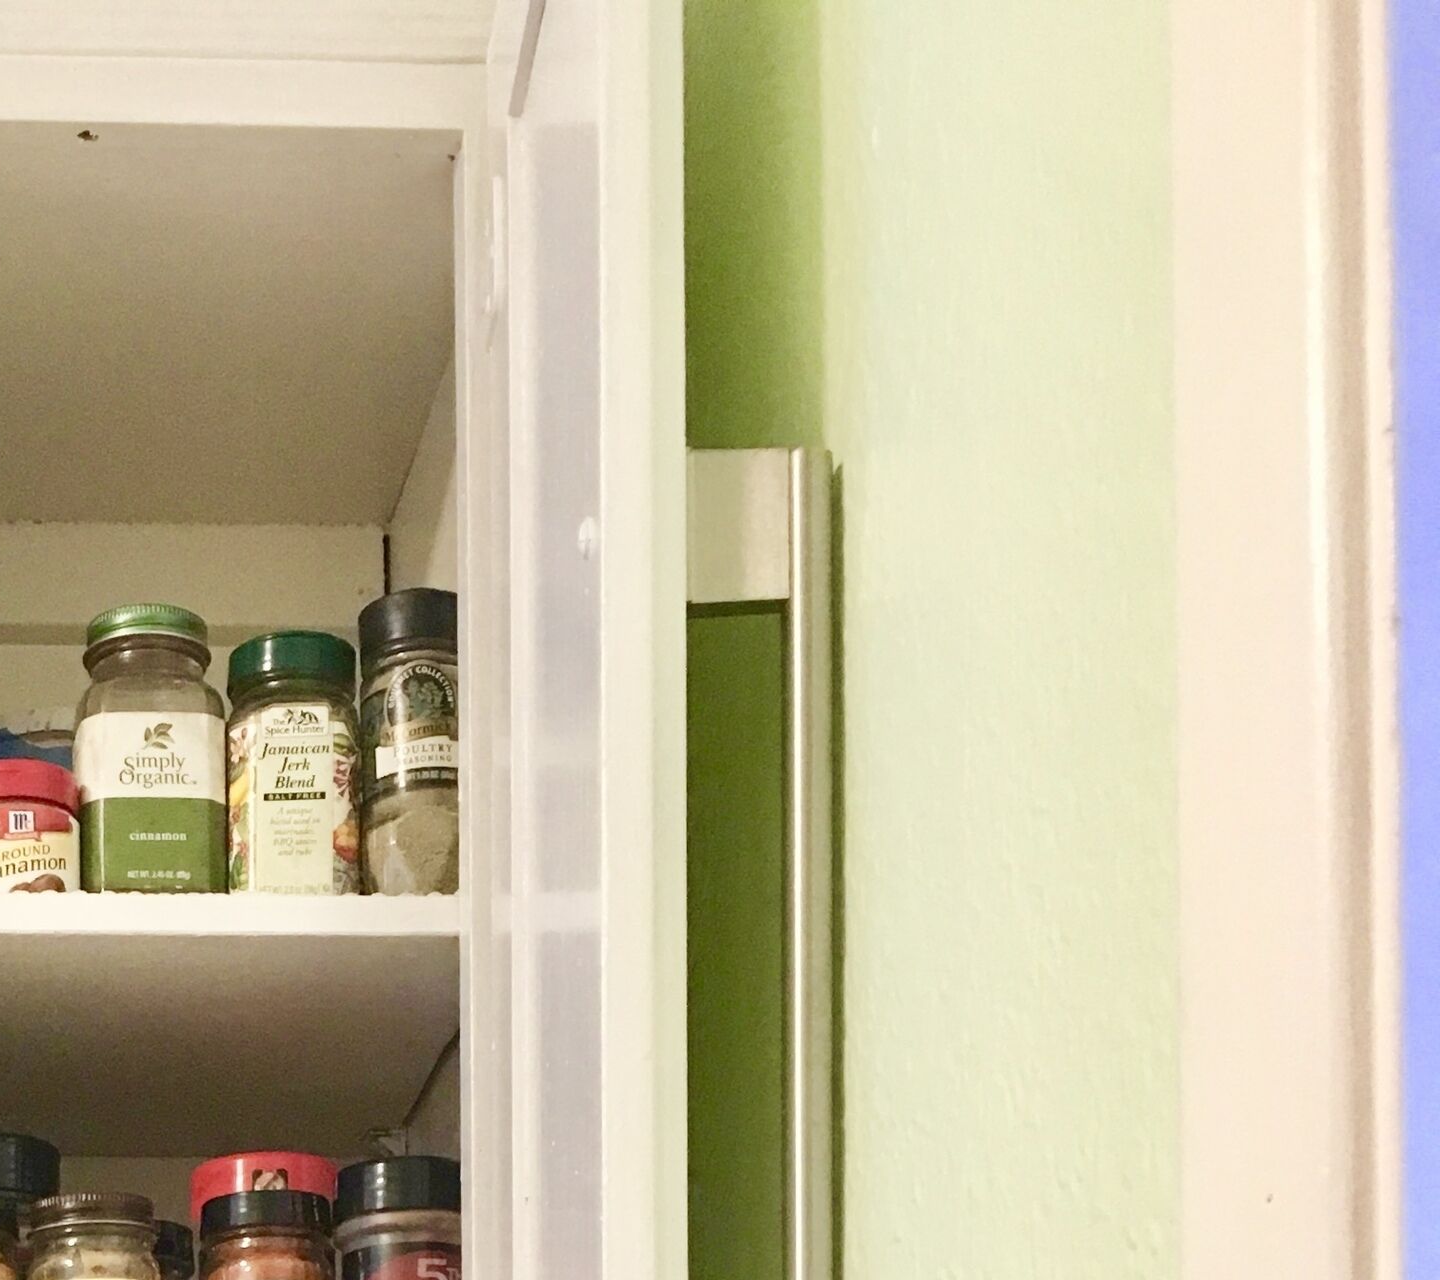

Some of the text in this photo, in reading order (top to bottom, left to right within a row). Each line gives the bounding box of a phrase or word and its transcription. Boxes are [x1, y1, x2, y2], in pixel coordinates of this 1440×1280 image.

[416, 665, 455, 702] COLLECTION
[265, 726, 324, 736] Spice Hunter
[258, 743, 330, 760] Jamaican
[394, 744, 453, 757] POULTRY
[124, 752, 186, 771] Simply
[278, 757, 311, 774] Jerk
[398, 755, 453, 765] EASONING
[119, 769, 190, 789] Organic
[275, 775, 316, 789] Blend
[129, 830, 188, 842] cinnamon
